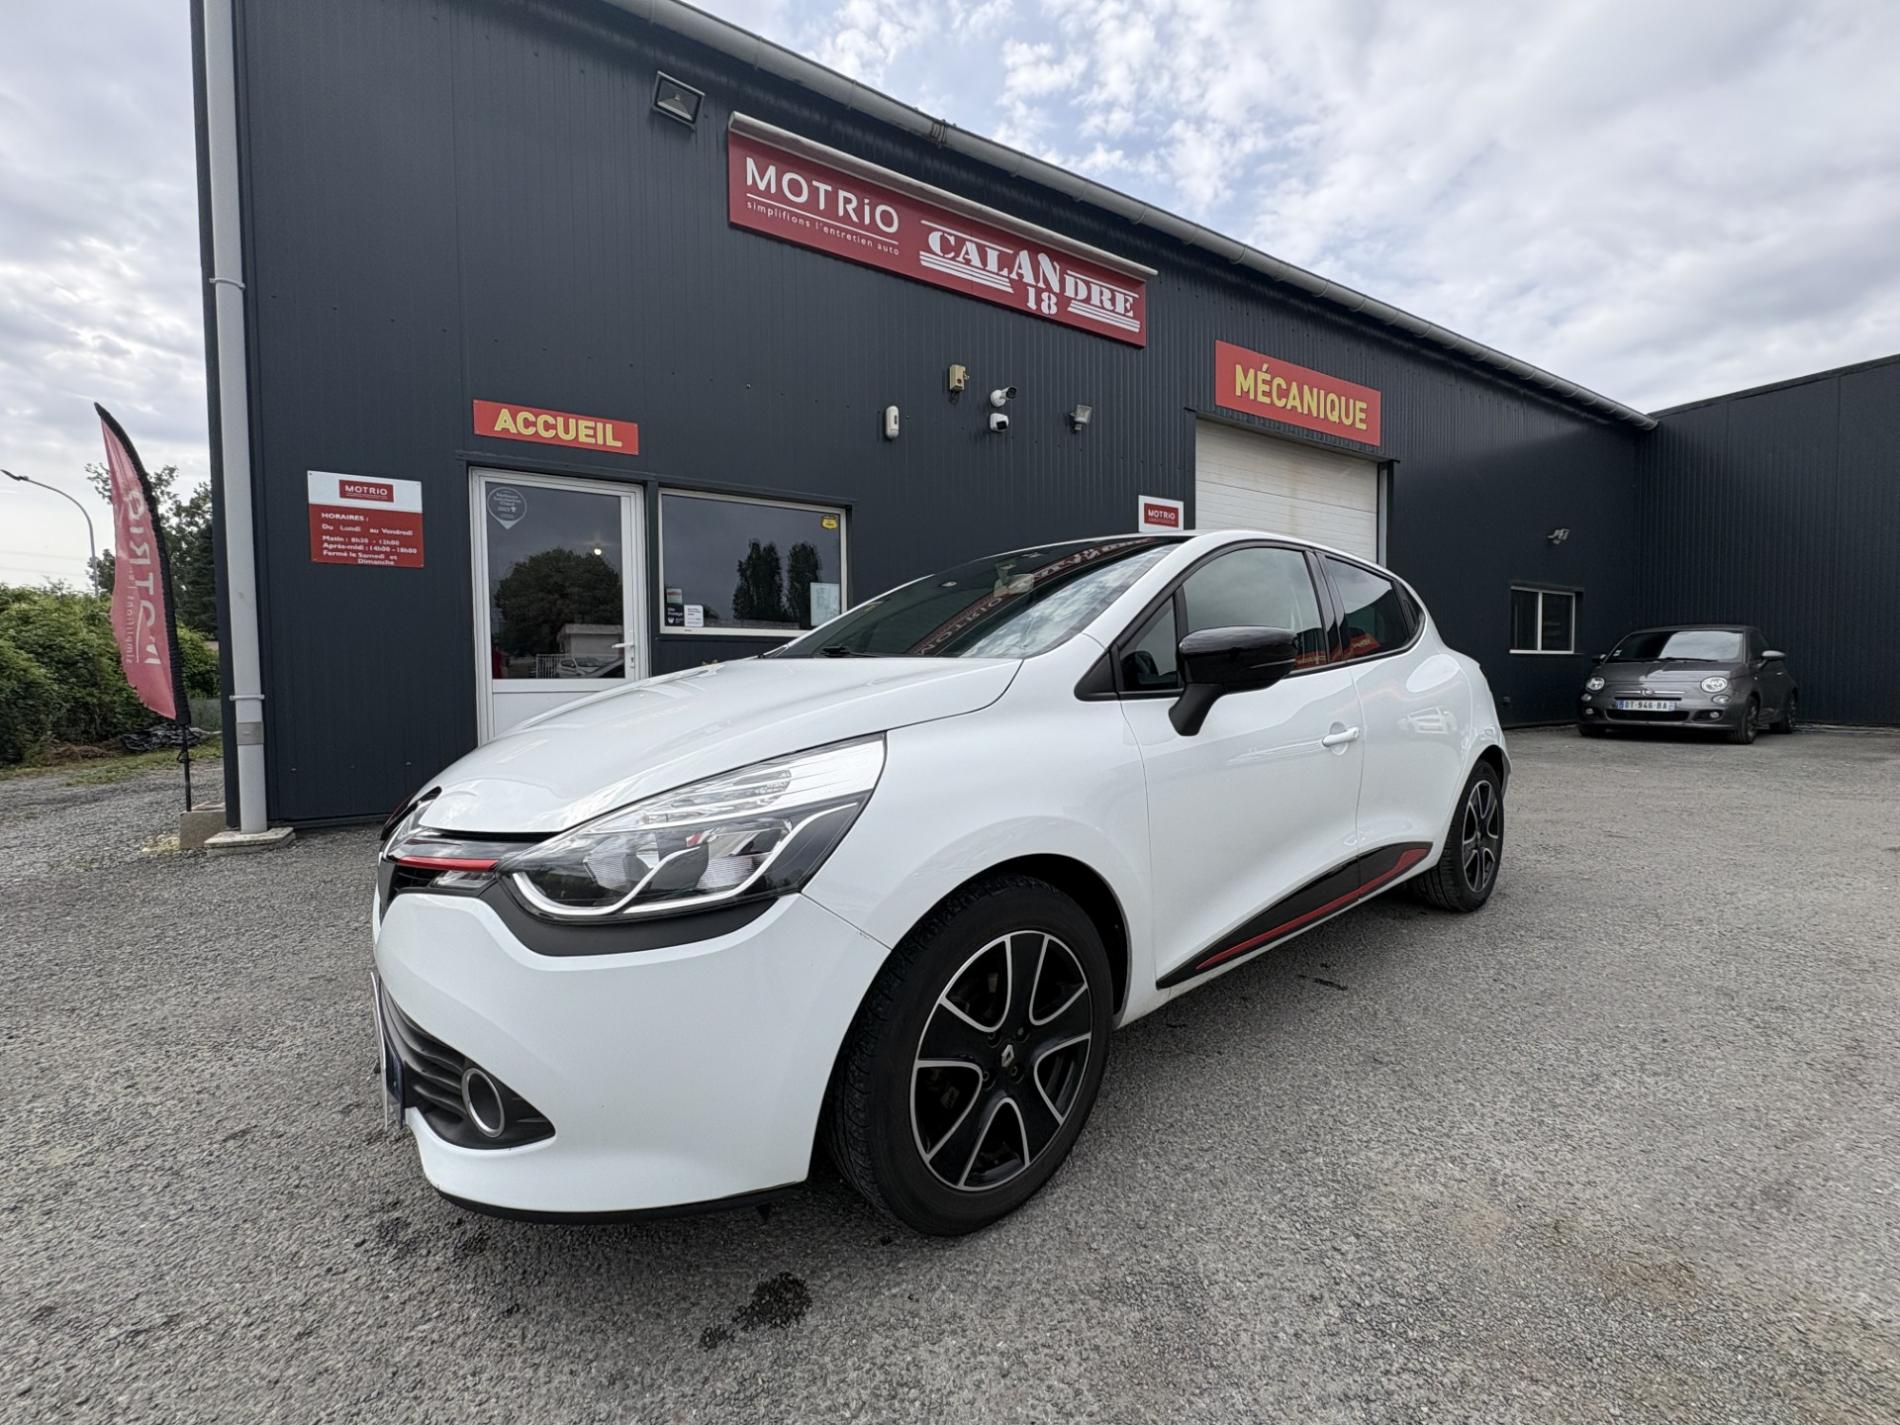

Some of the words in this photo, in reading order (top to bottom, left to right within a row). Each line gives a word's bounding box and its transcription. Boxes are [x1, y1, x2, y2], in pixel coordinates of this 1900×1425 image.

[746, 201, 811, 228] simplifions
[815, 221, 873, 247] l'entretien
[877, 243, 900, 256] auto
[1025, 285, 1058, 316] 18
[1234, 362, 1368, 431] MÉCANIQUE
[493, 407, 623, 448] ACCUEIL
